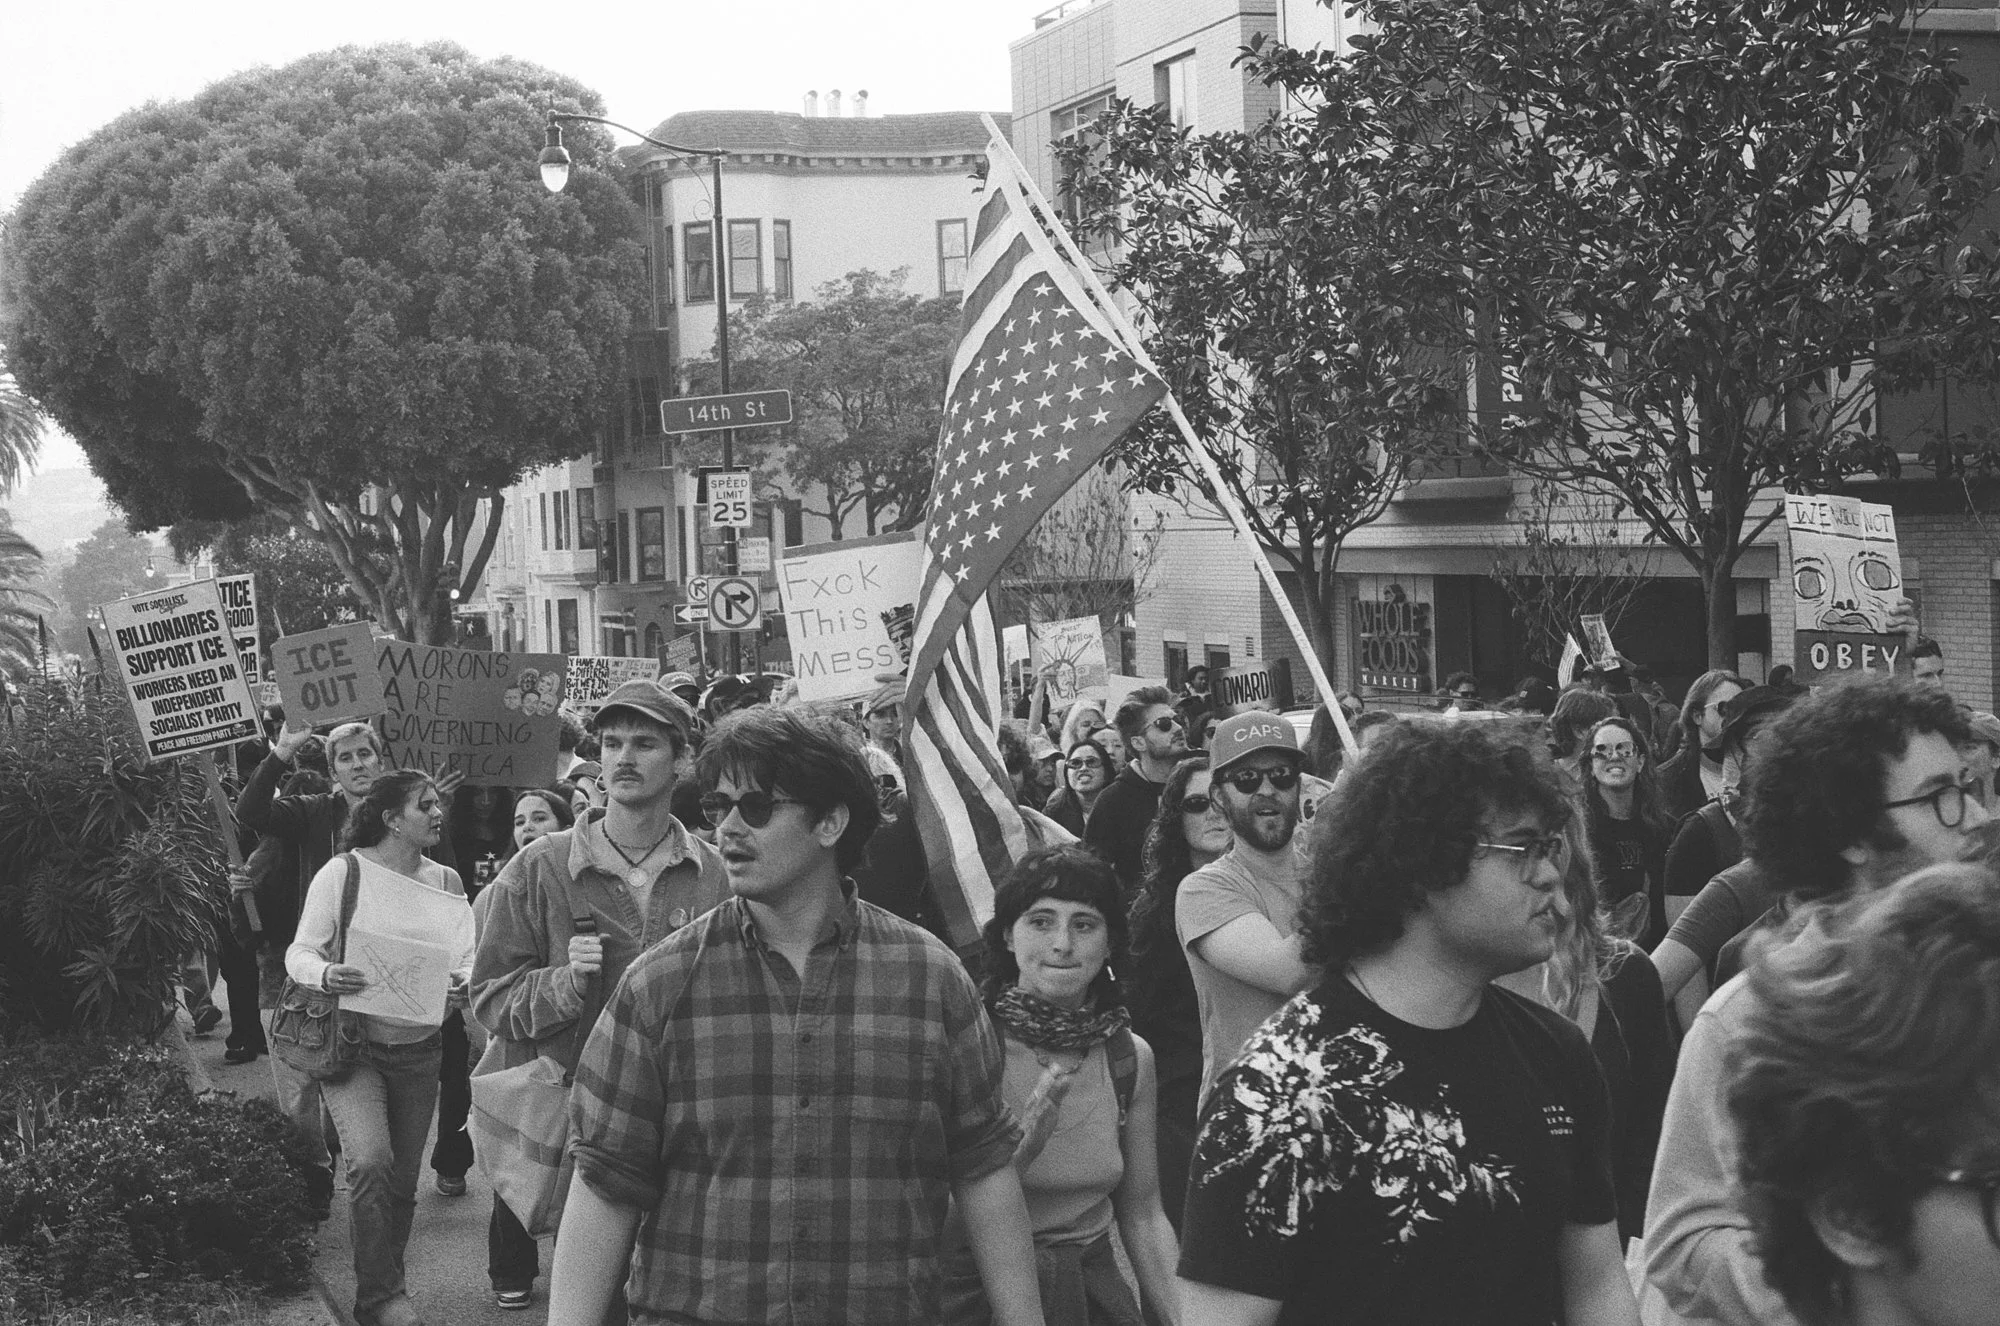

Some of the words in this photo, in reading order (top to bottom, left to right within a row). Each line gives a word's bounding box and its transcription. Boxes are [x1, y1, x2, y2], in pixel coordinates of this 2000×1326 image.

[688, 404, 731, 423] 14th
[745, 400, 766, 418] St
[710, 479, 748, 489] SPEED
[716, 490, 744, 500] LIMIT
[713, 501, 748, 523] 25
[1788, 501, 1831, 528] WE
[1830, 505, 1859, 527] WILL
[1863, 511, 1891, 533] NOT
[131, 602, 149, 614] VOTE
[149, 593, 185, 610] SOCIALIST
[690, 608, 704, 616] ONE
[1354, 600, 1420, 637] WHOLE
[116, 609, 219, 651] BILLIONAIRES
[125, 639, 197, 677] SUPPORT
[199, 635, 228, 663] ICE
[287, 638, 352, 676] ICE
[378, 645, 510, 679] MORONS
[575, 658, 595, 668] HAVE
[595, 658, 610, 669] ALL
[1360, 636, 1419, 673] FOODS
[1810, 642, 1899, 678] OBEY
[132, 675, 188, 701] WORKERS
[186, 666, 219, 691] NEED
[219, 663, 237, 682] AN
[301, 672, 358, 711] OUT
[383, 677, 452, 717] ARE
[589, 689, 609, 700] NOW
[597, 679, 609, 690] IN
[1362, 674, 1417, 689] MARKET
[151, 686, 226, 716] INDEPENDENT
[150, 708, 205, 737] SOCIALIST
[207, 702, 243, 725] PARTY
[379, 706, 532, 746] GOVERNING
[1233, 724, 1283, 743] CAPS
[157, 739, 176, 753] PEACE
[174, 736, 187, 749] AND
[186, 732, 212, 748] FREEDOM
[211, 728, 232, 743] PARTY
[382, 743, 514, 778] AMERICA
